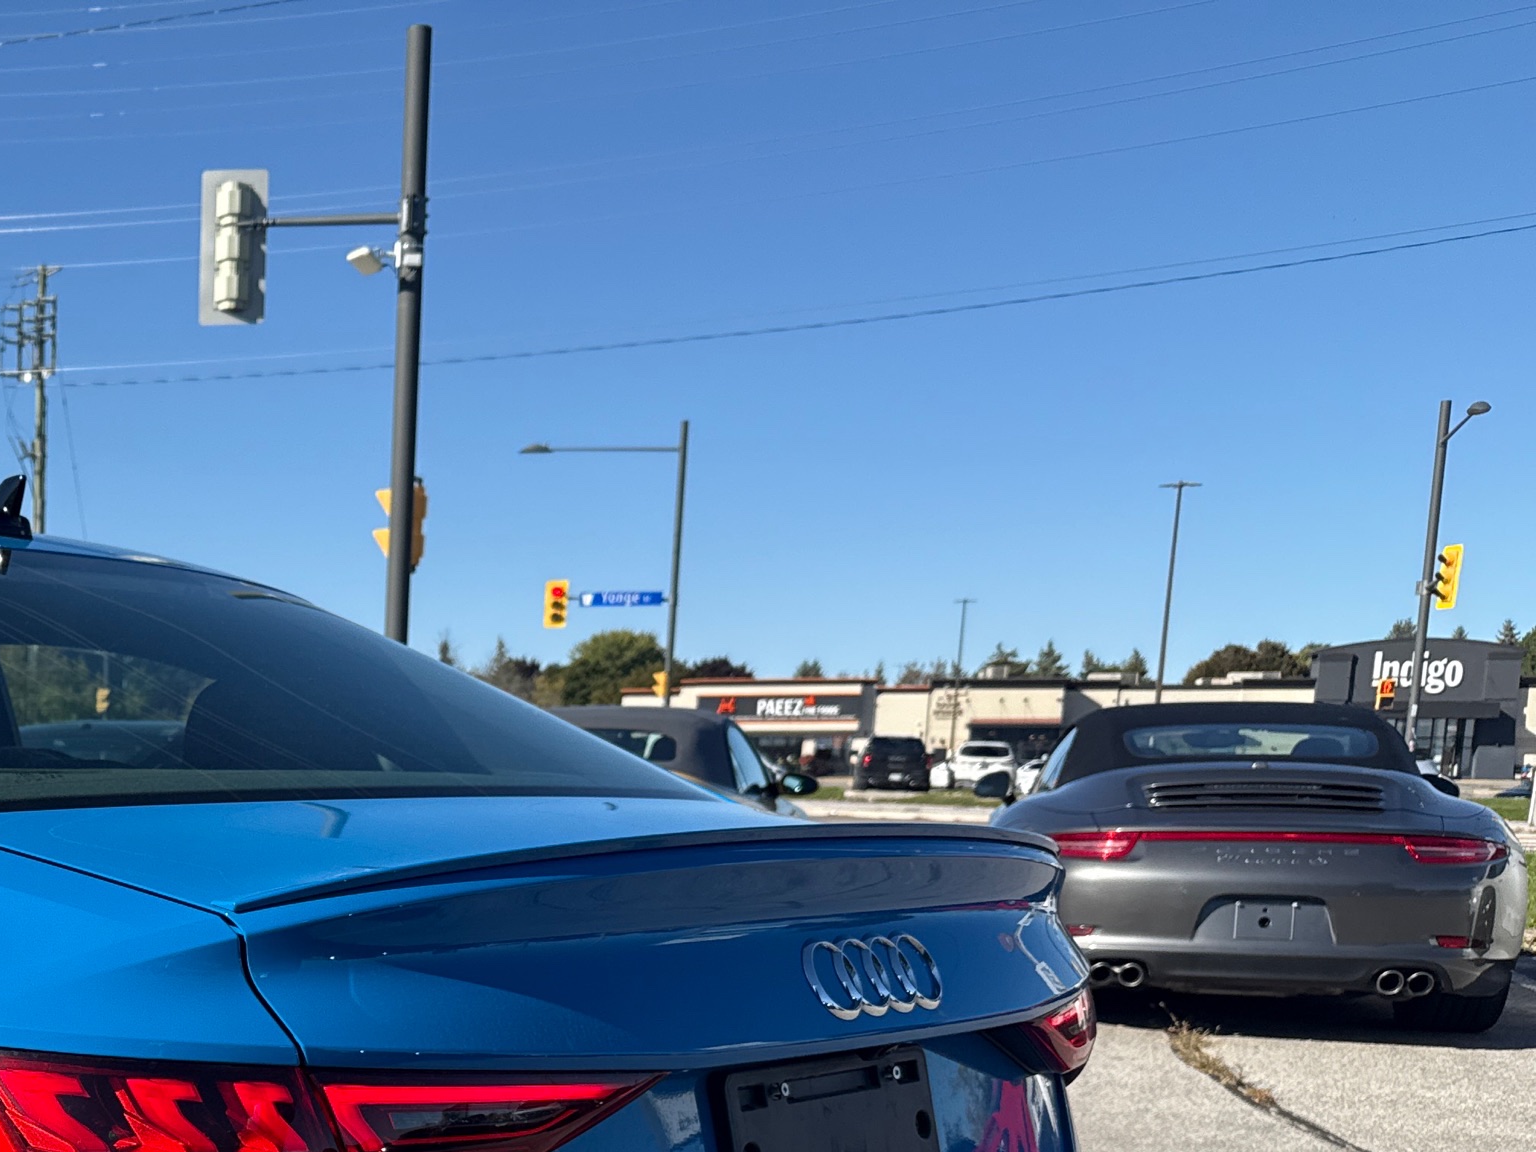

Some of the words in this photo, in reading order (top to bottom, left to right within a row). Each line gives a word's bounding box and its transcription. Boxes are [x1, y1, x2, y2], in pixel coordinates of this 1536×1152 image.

[601, 592, 640, 607] Yonge
[1371, 650, 1464, 694] Indigo
[756, 698, 804, 717] PAEEZ
